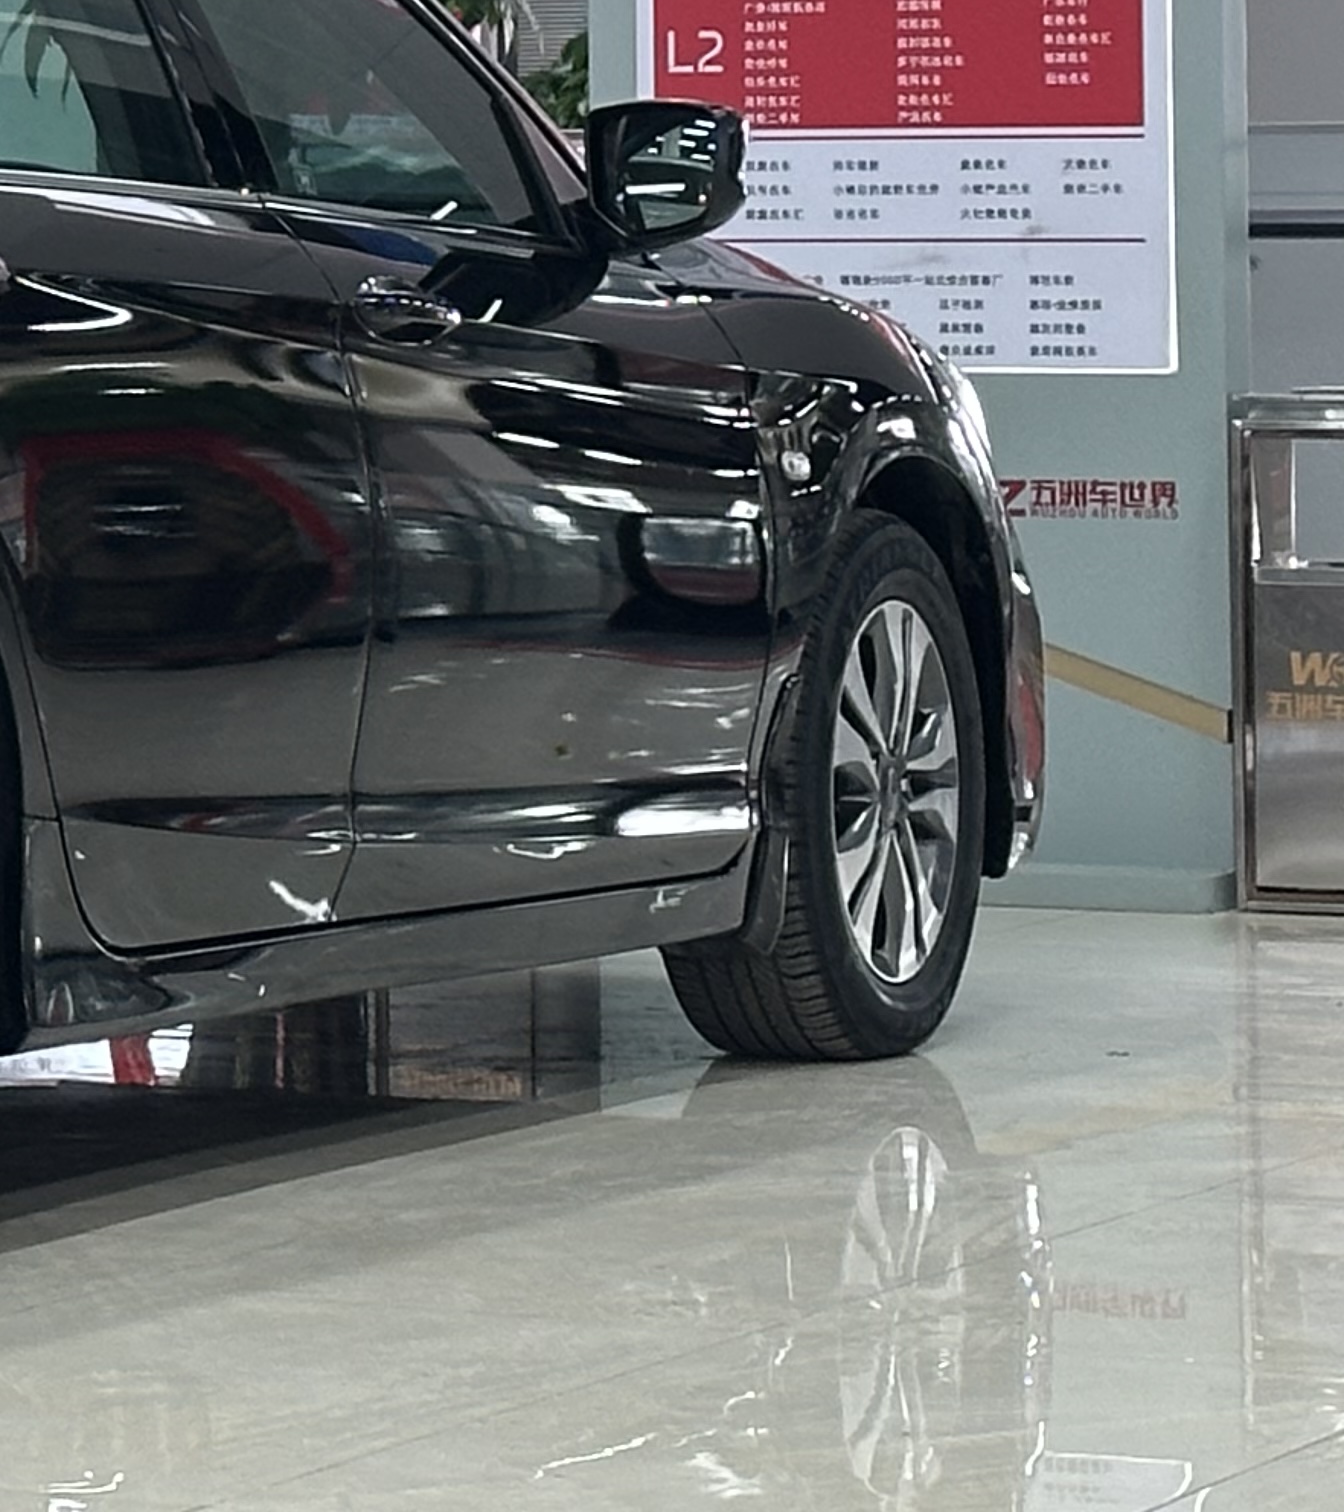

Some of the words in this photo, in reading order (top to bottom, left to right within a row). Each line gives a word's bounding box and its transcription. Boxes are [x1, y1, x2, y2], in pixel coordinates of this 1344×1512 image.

[666, 29, 724, 73] L2
[1029, 478, 1178, 508] 五洲车世界
